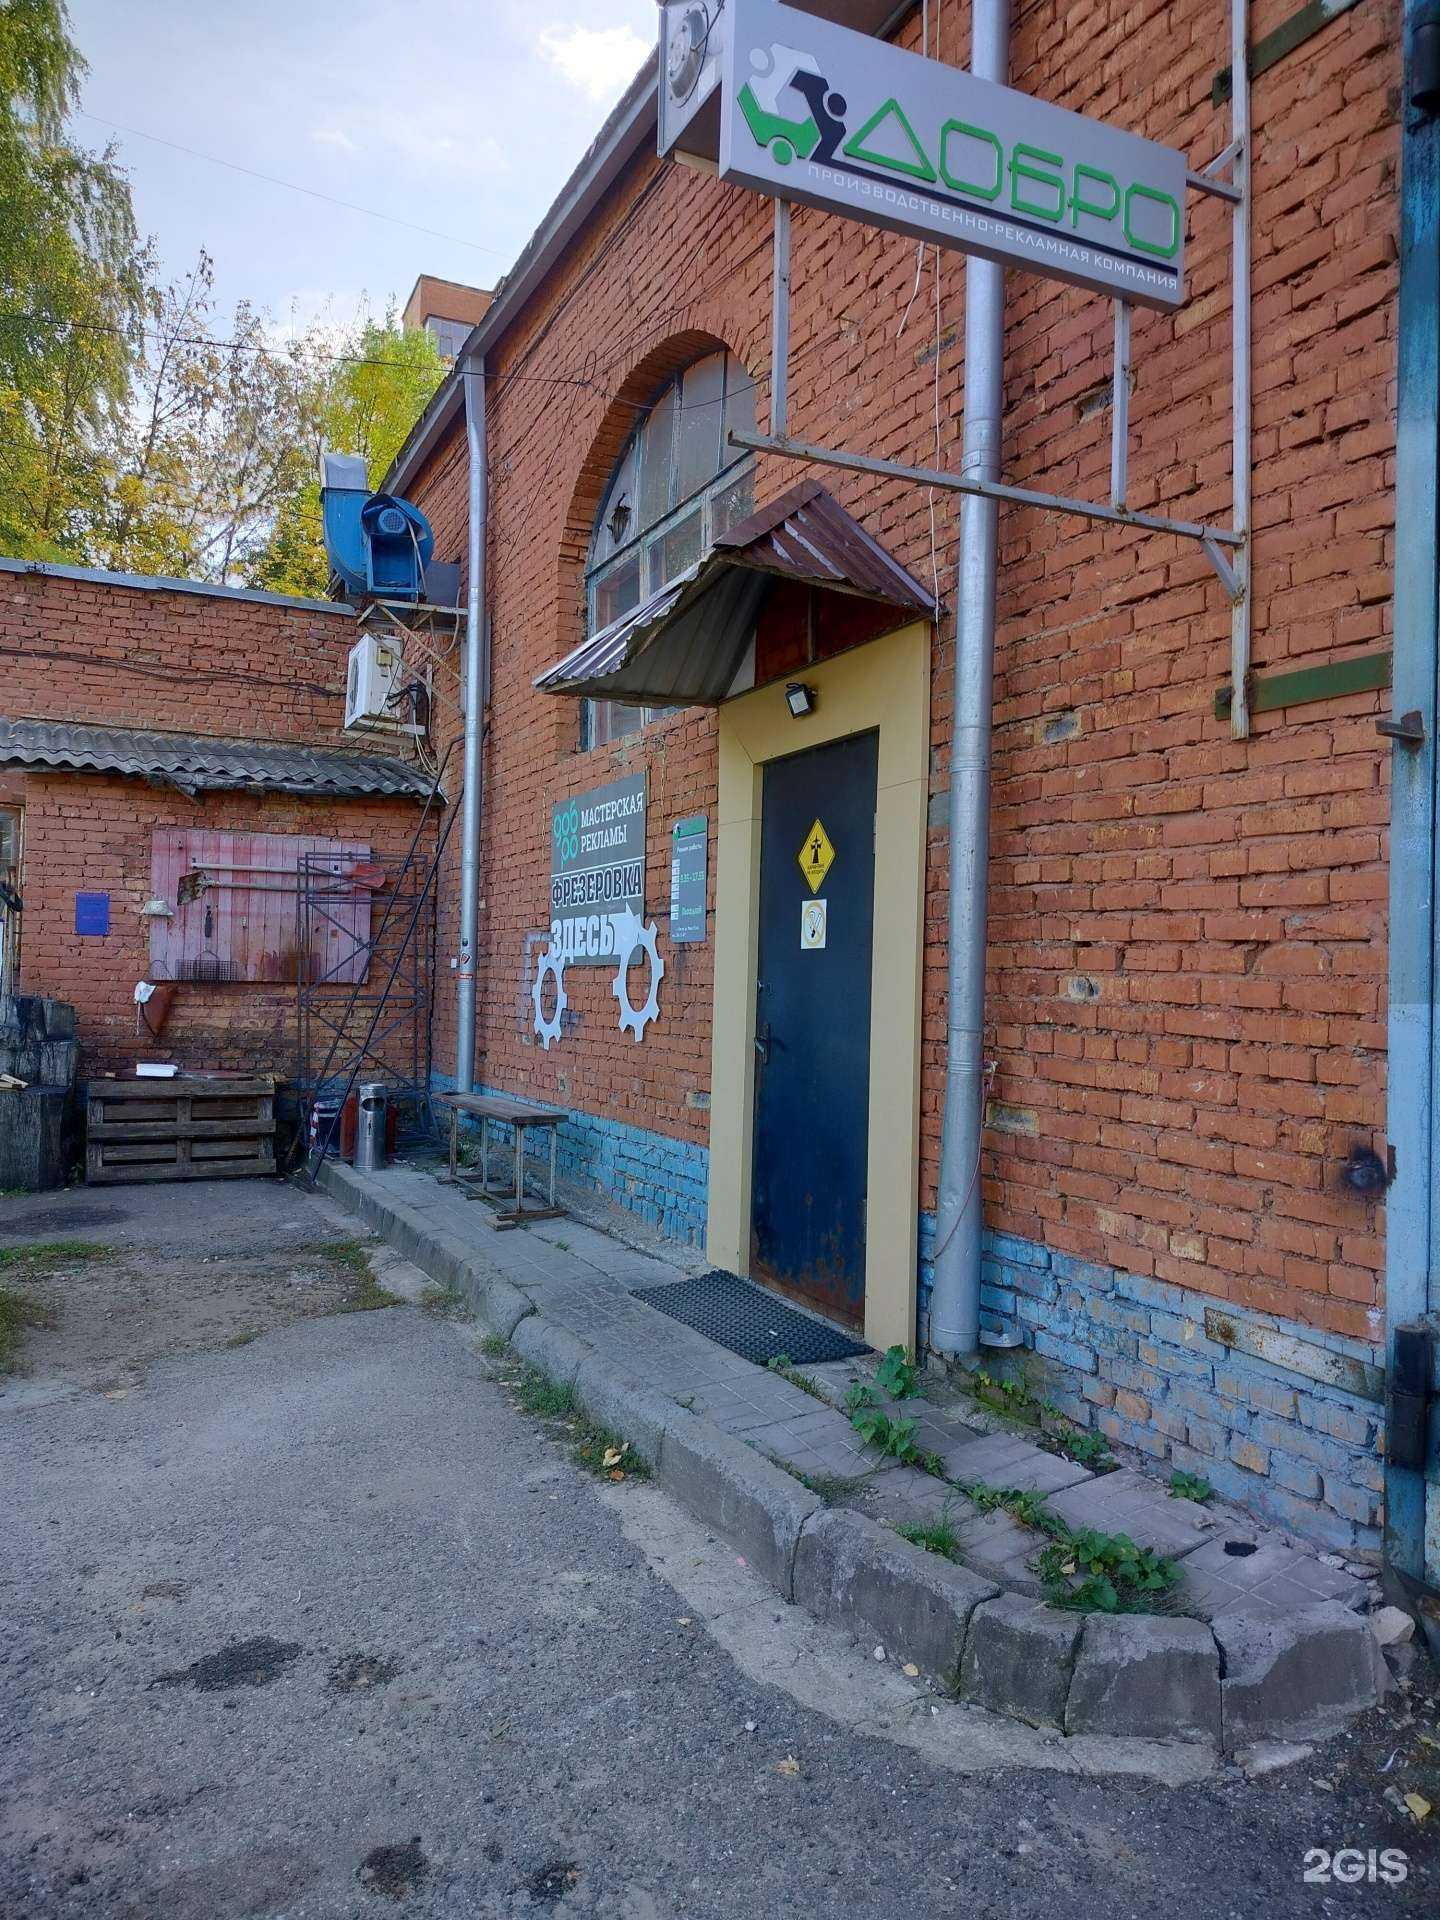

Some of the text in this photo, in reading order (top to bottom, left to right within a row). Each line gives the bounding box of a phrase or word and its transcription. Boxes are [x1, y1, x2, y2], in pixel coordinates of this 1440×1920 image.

[843, 97, 1180, 259] ДОБРО
[808, 164, 1178, 290] ПРОИЗВОДСТВЕННО-РЕКЛАМНАЯ КОМПАНИЯ
[580, 791, 644, 828] МАСТЕРСКАЯ
[580, 824, 628, 853] РЕКЛАМЫ
[551, 862, 643, 908] ФРЕЗЕРОВКА
[551, 913, 616, 964] ЗДЕСЬ
